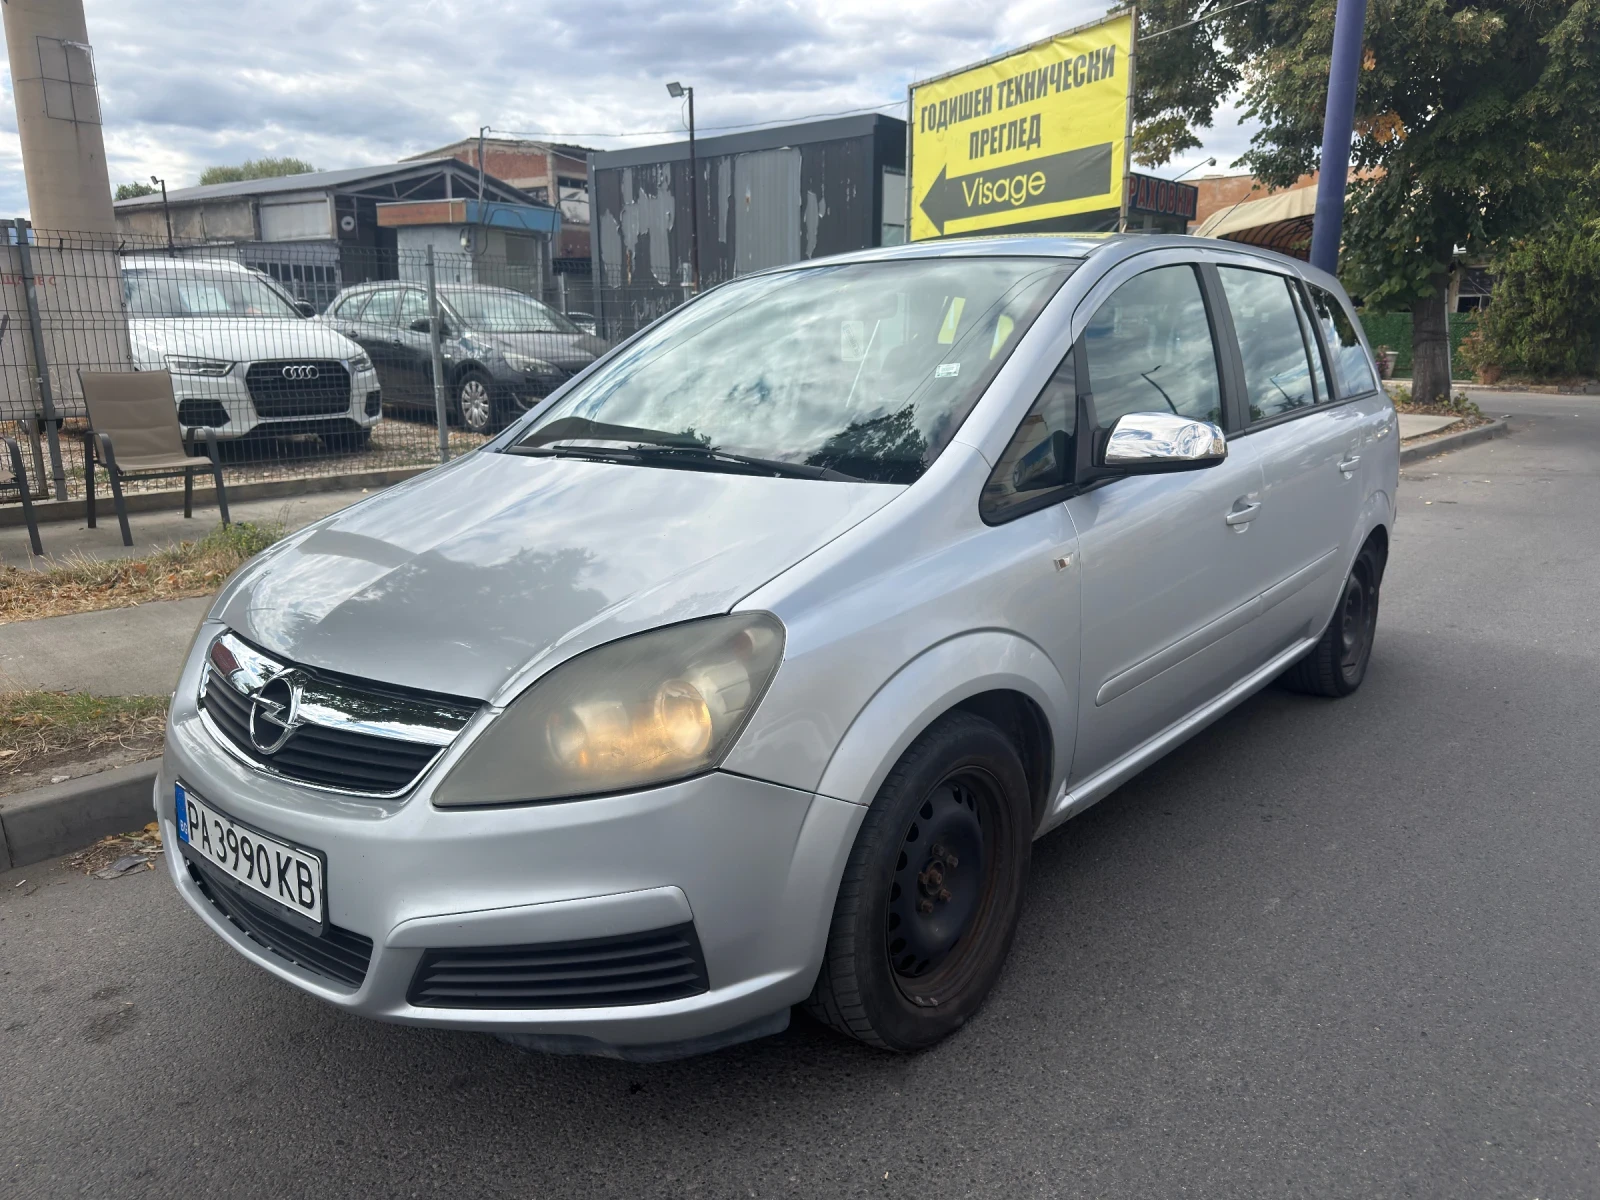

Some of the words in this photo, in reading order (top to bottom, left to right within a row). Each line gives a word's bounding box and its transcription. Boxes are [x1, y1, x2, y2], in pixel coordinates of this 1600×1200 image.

[920, 84, 994, 134] ГОДИШЕН
[996, 44, 1117, 111] ТЕХНИЧЕСКИ
[968, 112, 1042, 161] ПРЕГЛЕД
[961, 170, 1047, 208] Visage
